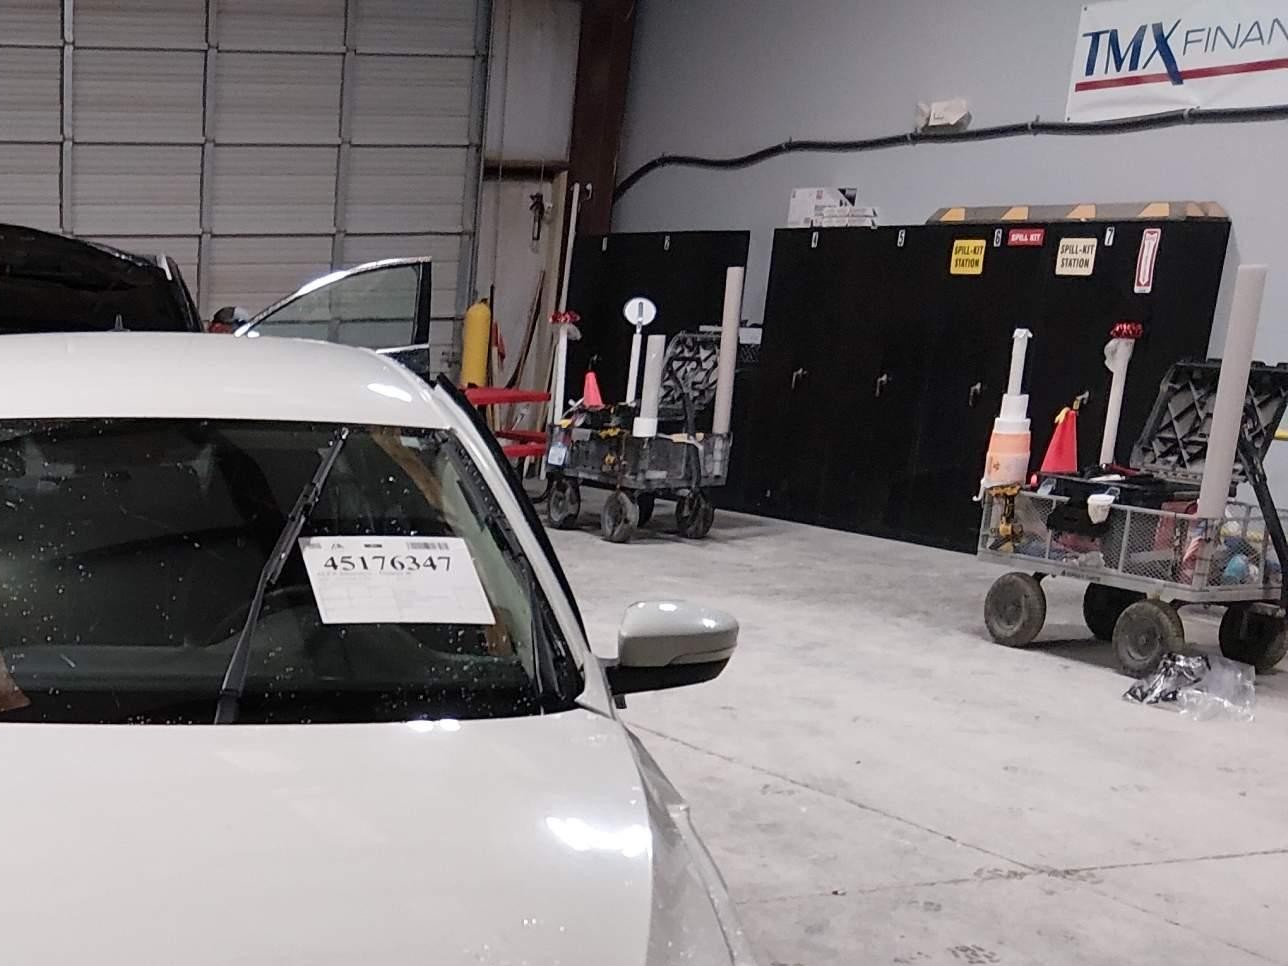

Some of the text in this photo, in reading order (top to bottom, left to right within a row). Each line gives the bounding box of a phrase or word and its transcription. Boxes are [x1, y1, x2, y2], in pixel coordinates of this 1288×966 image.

[1082, 18, 1184, 86] TMX
[1011, 233, 1042, 242] SPILL KIT
[954, 245, 984, 256] SPILL-KIT
[1060, 244, 1095, 255] SPILL-KIT
[954, 258, 980, 268] STATION
[1060, 258, 1090, 269] STATION
[324, 555, 450, 572] 45176347
